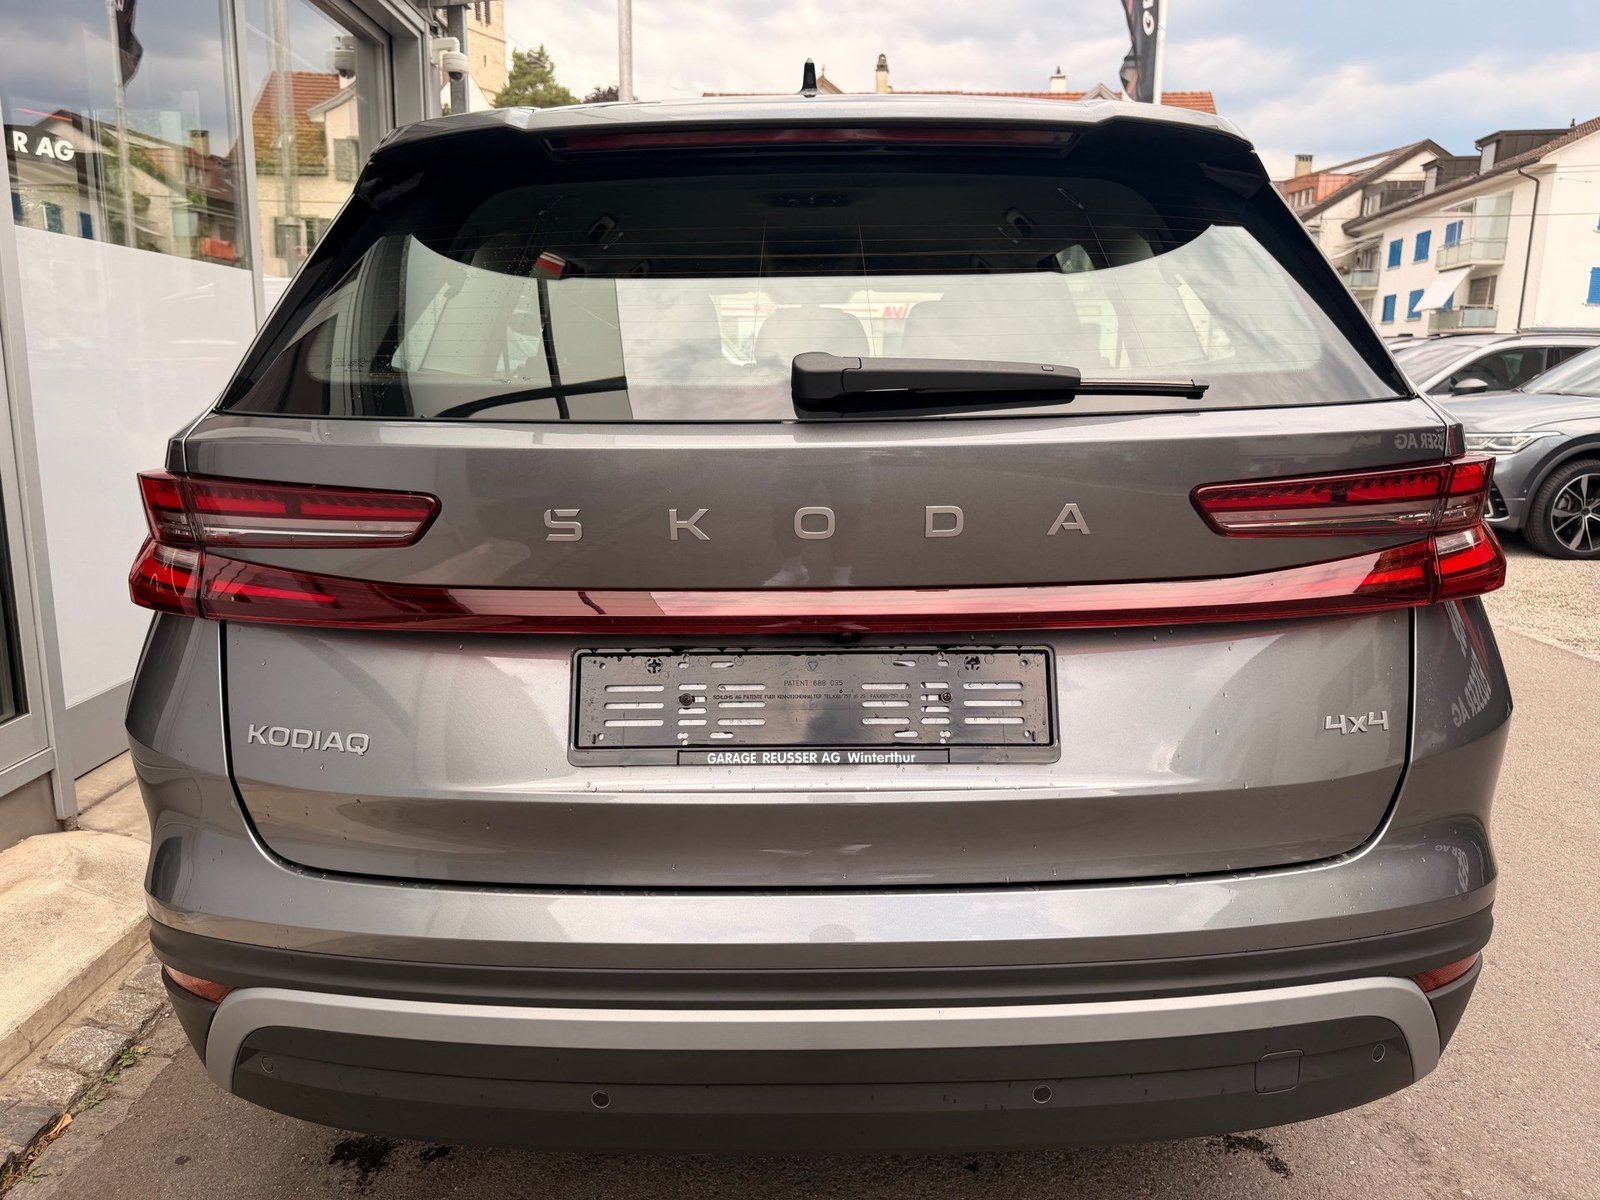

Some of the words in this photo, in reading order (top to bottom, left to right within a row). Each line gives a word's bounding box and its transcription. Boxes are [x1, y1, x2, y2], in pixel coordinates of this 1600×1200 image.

[35, 136, 75, 162] AG
[543, 502, 1092, 542] SKODA
[783, 679, 809, 687] PATENT
[1324, 710, 1389, 735] 4x4
[247, 723, 370, 756] KODIAQ
[707, 752, 757, 764] GARAGE
[762, 752, 817, 764] REUSSER
[821, 752, 841, 764] AG
[848, 752, 916, 764] Winterthur
